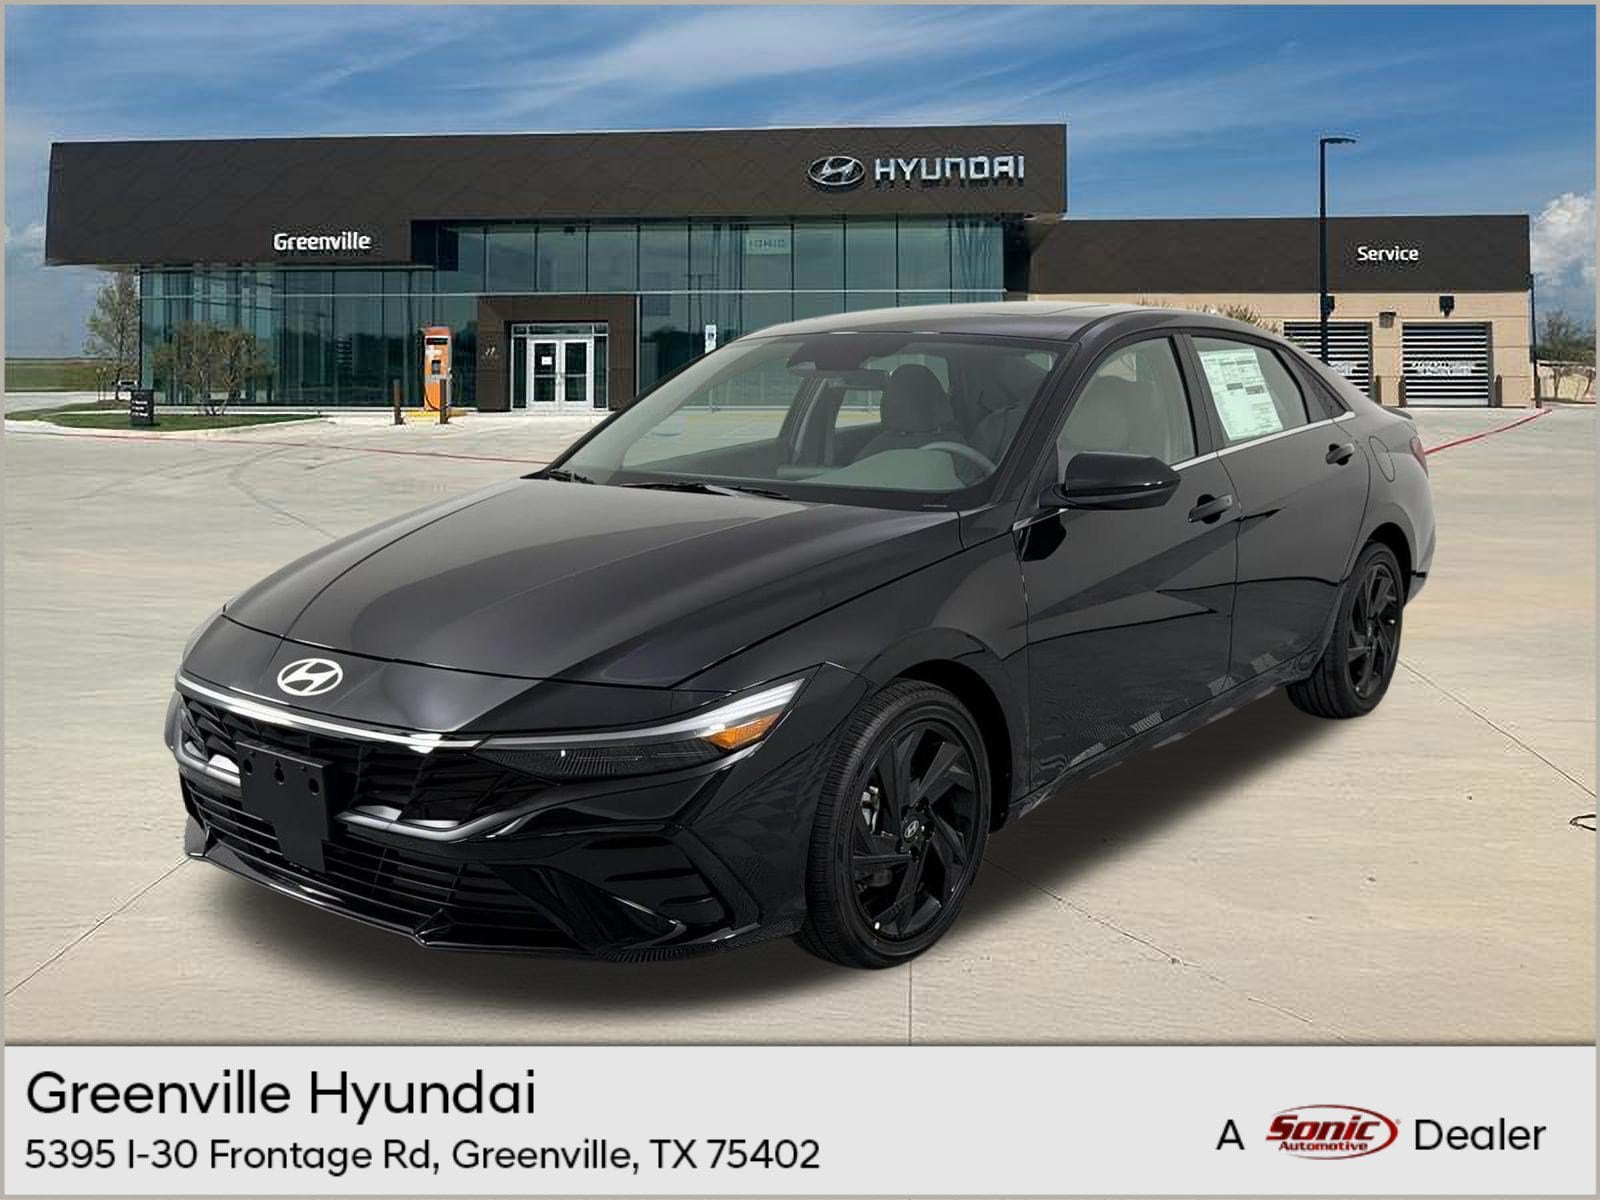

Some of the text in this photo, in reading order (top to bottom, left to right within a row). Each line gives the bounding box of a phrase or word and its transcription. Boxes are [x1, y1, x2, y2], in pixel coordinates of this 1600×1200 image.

[875, 155, 1025, 181] HYUNDAI
[273, 231, 372, 251] Greenville
[1357, 245, 1419, 261] Service
